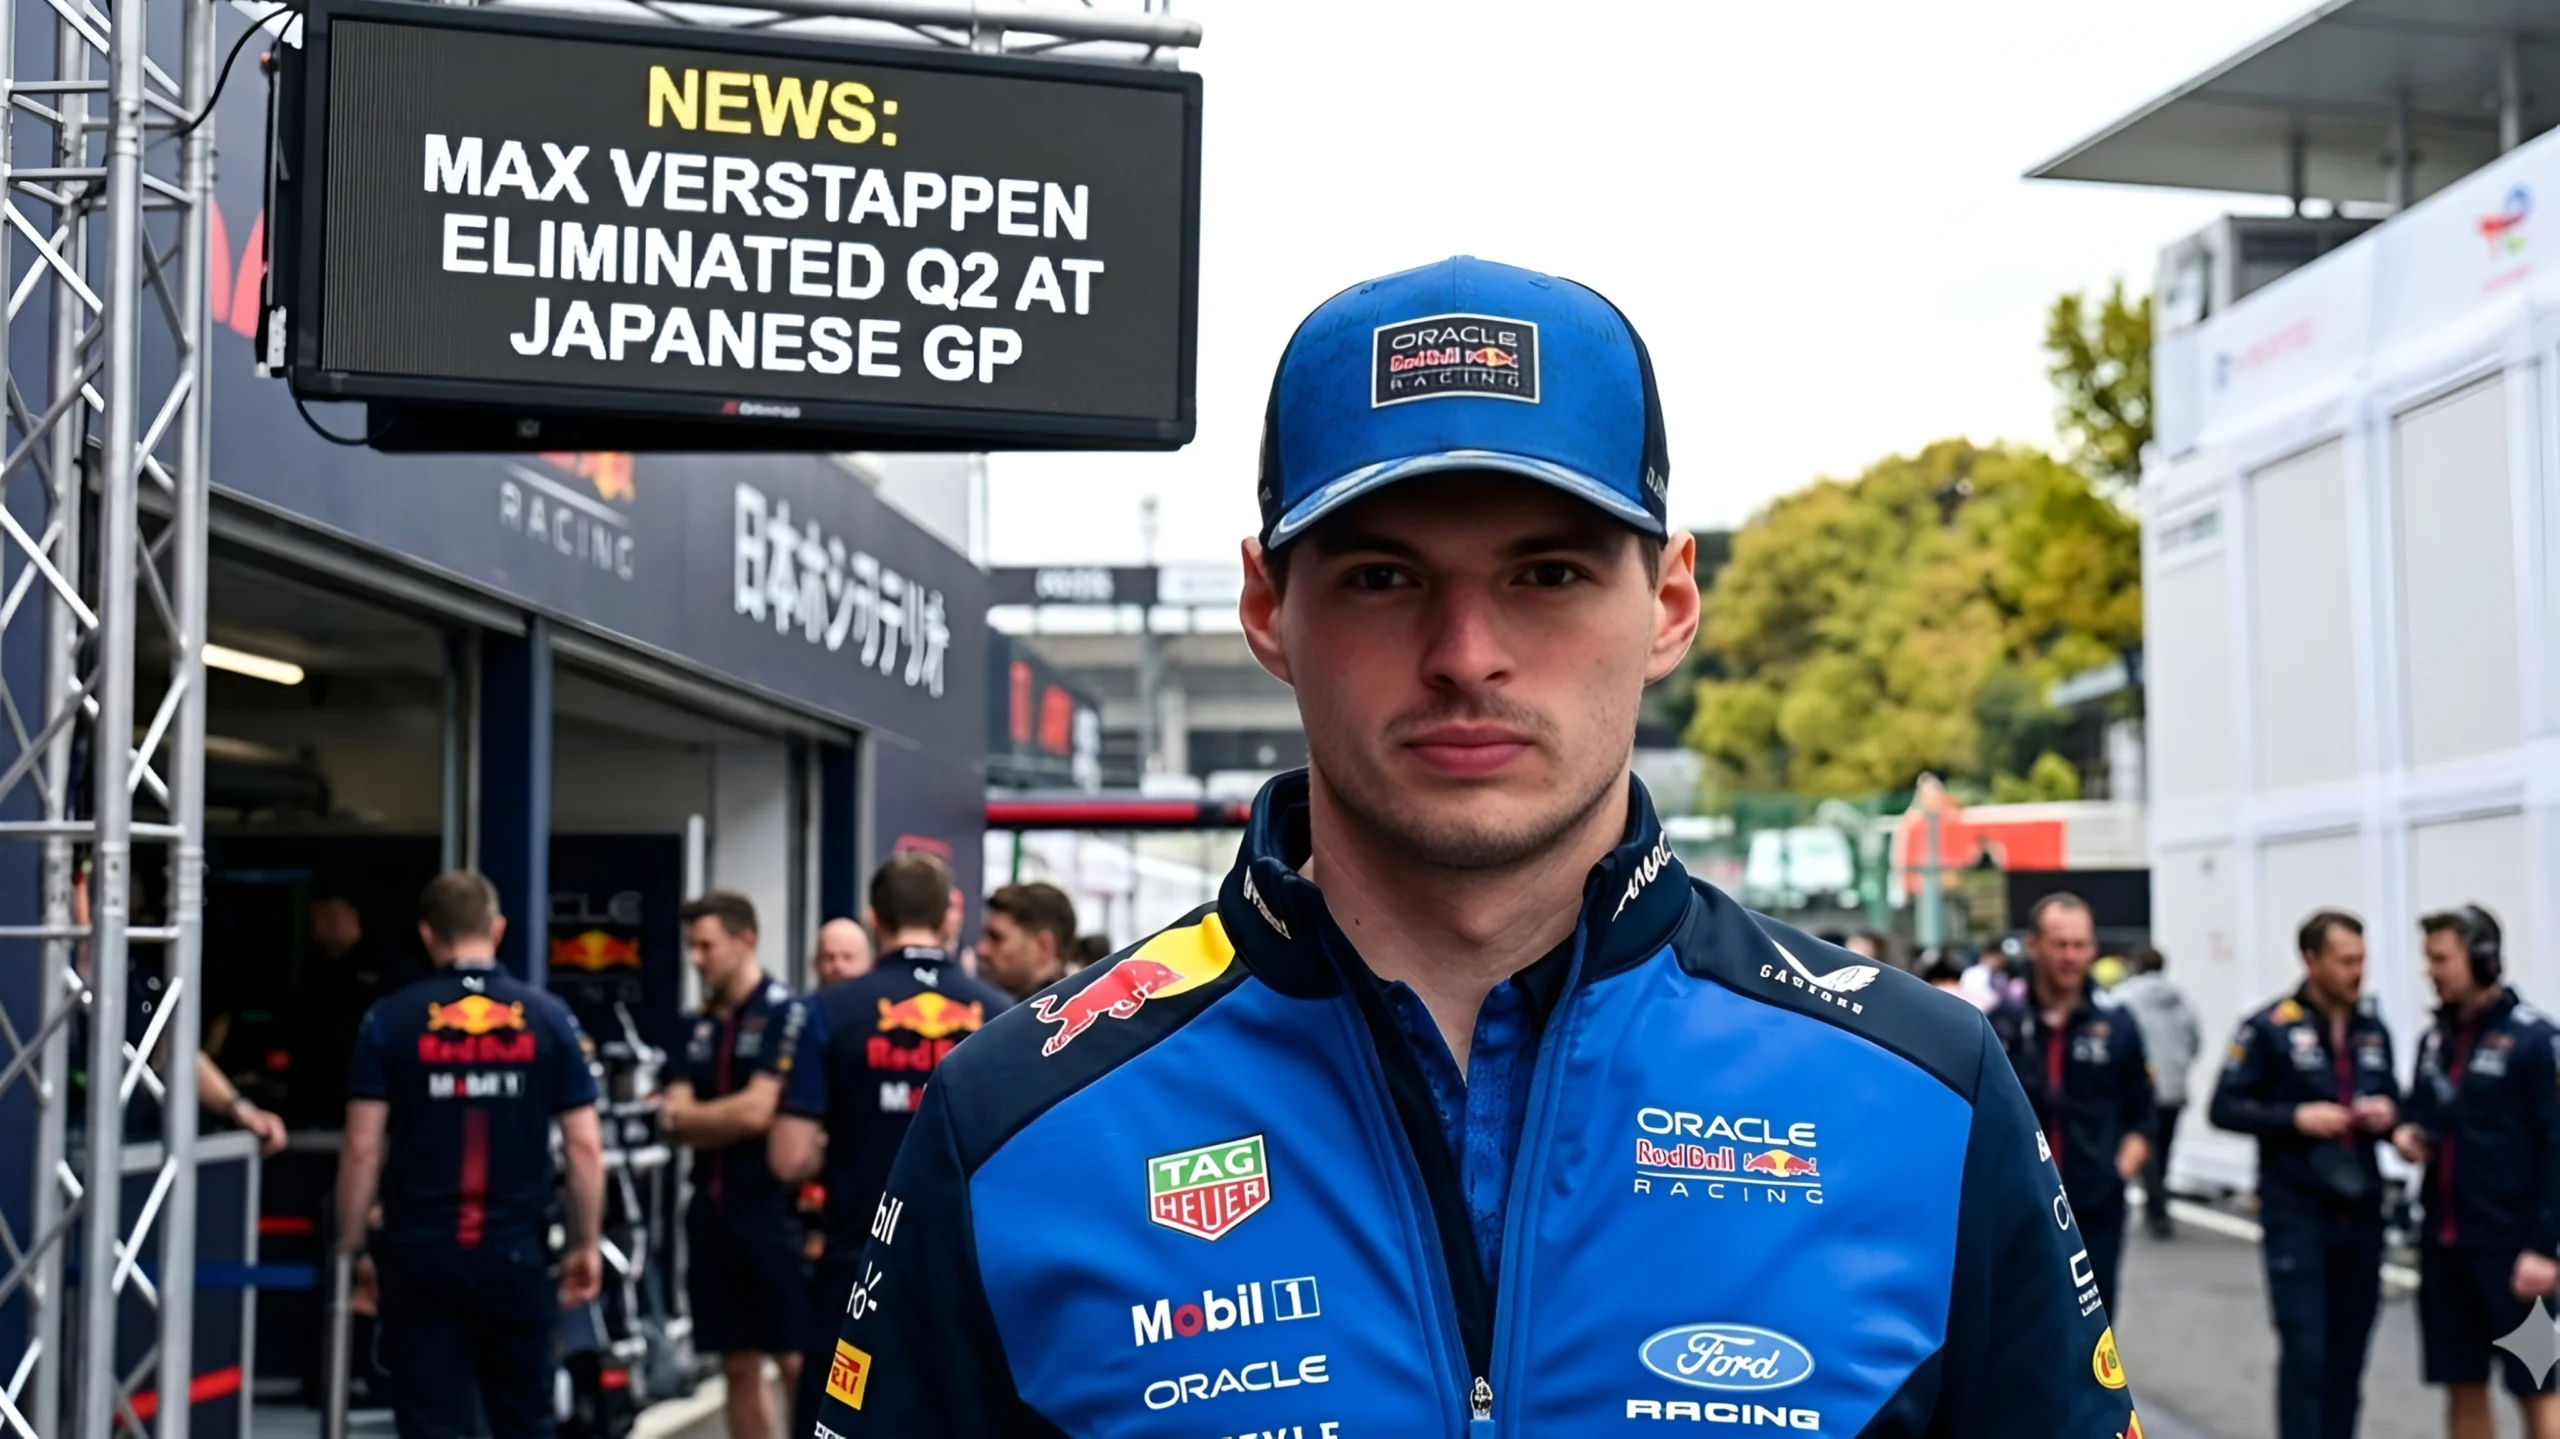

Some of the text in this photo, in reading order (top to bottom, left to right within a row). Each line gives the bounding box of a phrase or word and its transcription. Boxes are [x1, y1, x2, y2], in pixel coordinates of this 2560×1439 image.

[648, 65, 898, 147] NEWS:
[423, 133, 1089, 241] MAX VERSTAPPEN
[442, 212, 1105, 315] ELIMINATED Q2 AT
[509, 297, 1023, 384] JAPANESE GP
[1391, 325, 1518, 350] ORACLE
[500, 479, 635, 582] RACING
[1636, 1106, 1818, 1148] ORACLE
[1159, 1145, 1256, 1187] TAG
[1159, 1180, 1261, 1231] HEUER
[1131, 1281, 1265, 1347] Mobil
[1143, 1354, 1330, 1410] ORACLE
[1675, 1331, 1782, 1380] Ford
[1626, 1398, 1821, 1431] RACING
